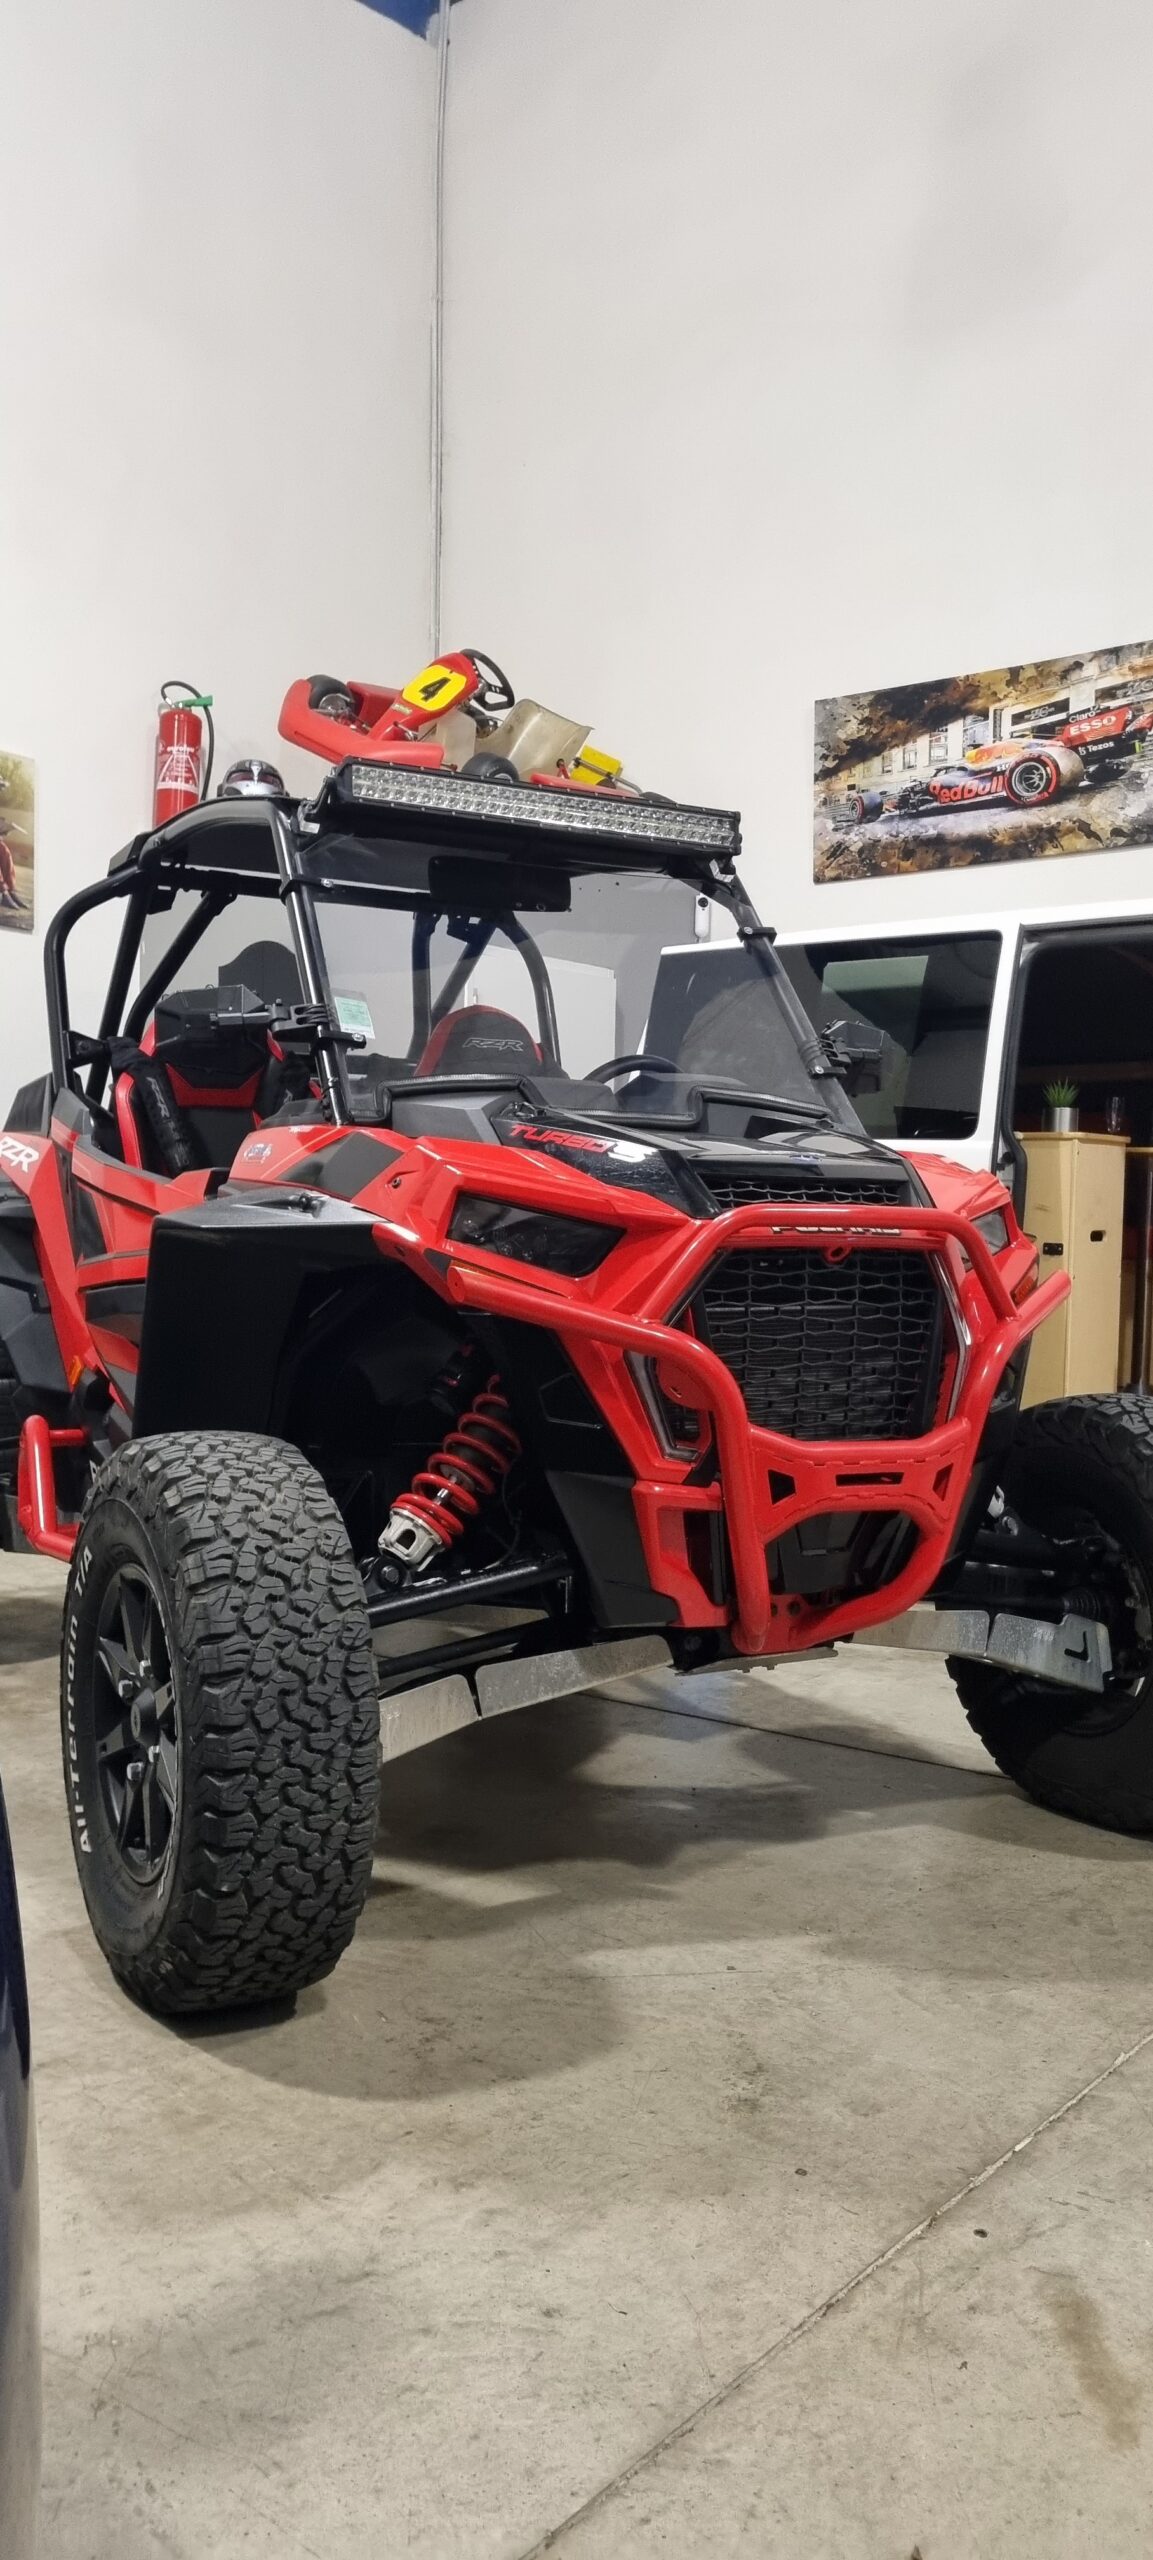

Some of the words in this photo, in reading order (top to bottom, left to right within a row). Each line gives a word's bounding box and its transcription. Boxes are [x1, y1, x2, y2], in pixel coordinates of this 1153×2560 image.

[419, 677, 452, 703] 4
[1069, 715, 1116, 736] ESSO
[1087, 741, 1115, 753] Tezos
[462, 1037, 523, 1052] RZR
[508, 1123, 618, 1153] TURBO
[74, 1545, 93, 1597] T/A
[66, 1614, 92, 1853] All-Terrain
